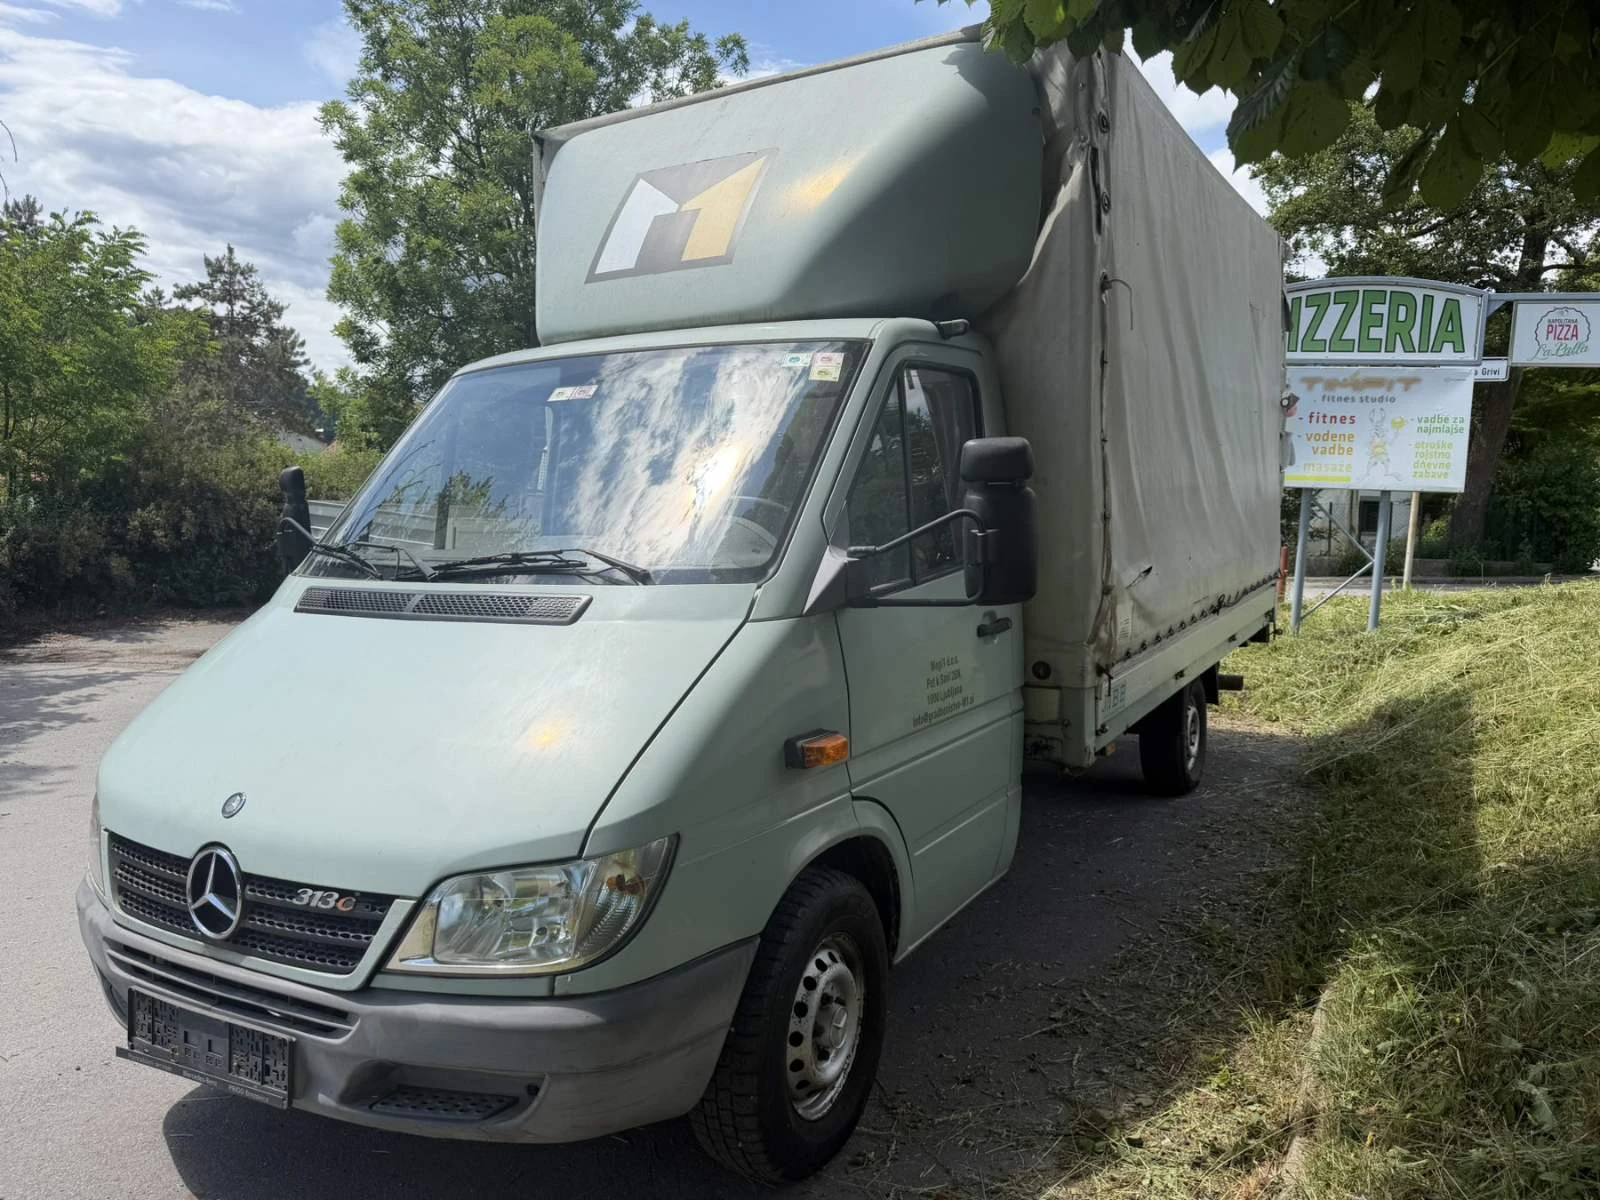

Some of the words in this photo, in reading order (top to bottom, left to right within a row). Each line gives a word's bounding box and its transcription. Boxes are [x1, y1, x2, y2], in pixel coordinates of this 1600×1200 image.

[1287, 289, 1465, 353] IZZERIA
[1546, 324, 1578, 341] PIZZA
[1482, 367, 1500, 376] Grivi
[1321, 394, 1355, 403] fitnes
[1359, 394, 1396, 404] studio
[1308, 411, 1356, 425] fitnes
[1417, 414, 1450, 424] vadbe
[1452, 416, 1465, 424] za
[1306, 430, 1355, 442] vodene
[1312, 443, 1354, 456] vadbe
